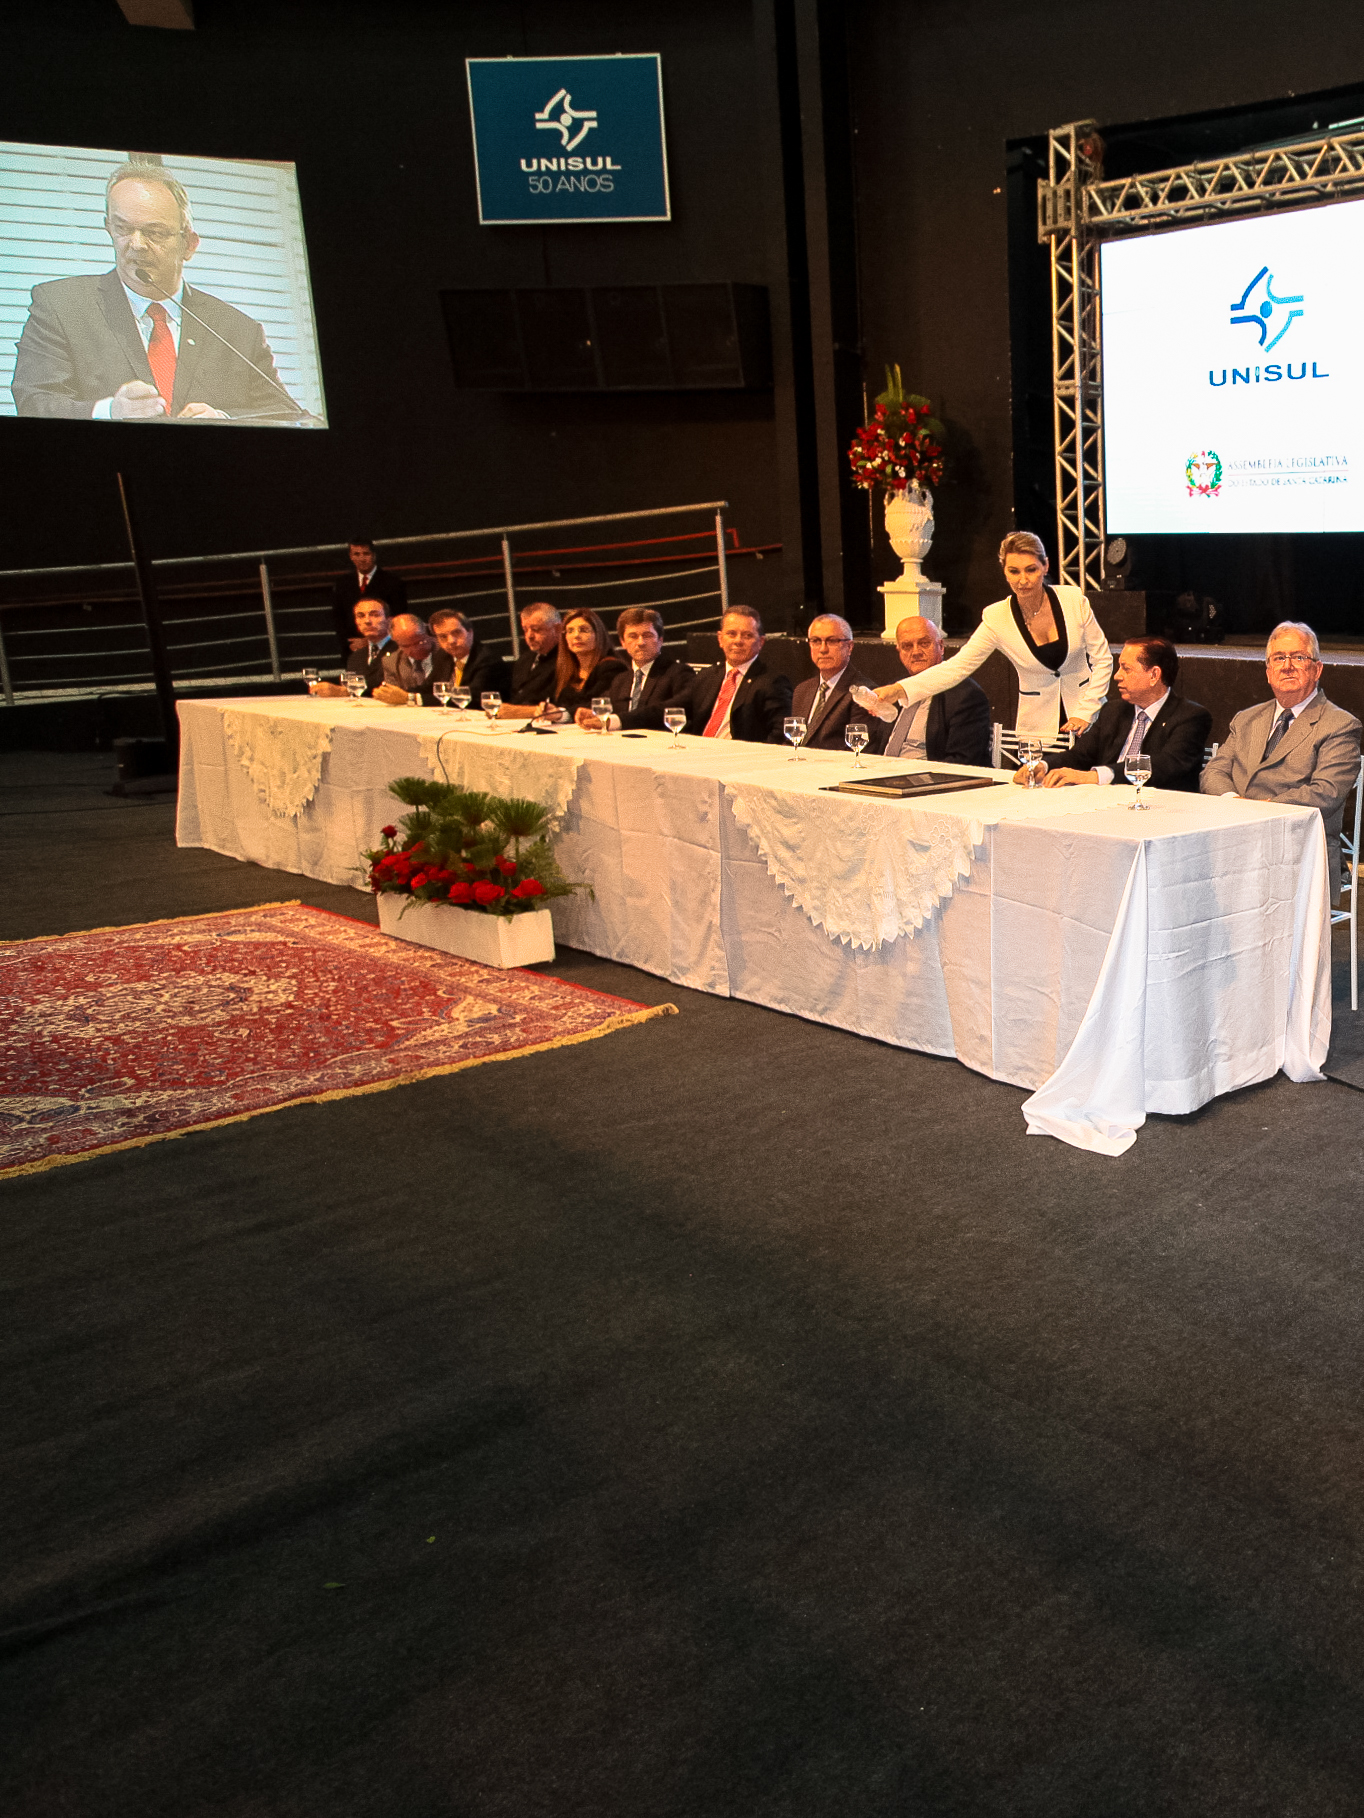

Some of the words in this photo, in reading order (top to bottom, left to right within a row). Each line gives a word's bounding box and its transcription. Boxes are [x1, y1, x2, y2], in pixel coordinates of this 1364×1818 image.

[520, 156, 621, 172] UNISUL
[528, 176, 553, 194] 50
[556, 174, 615, 193] ANOS
[1209, 361, 1330, 387] UNISUL
[1227, 459, 1283, 470] ASSEMBLEIA
[1286, 455, 1349, 468] LEGISLATIVA
